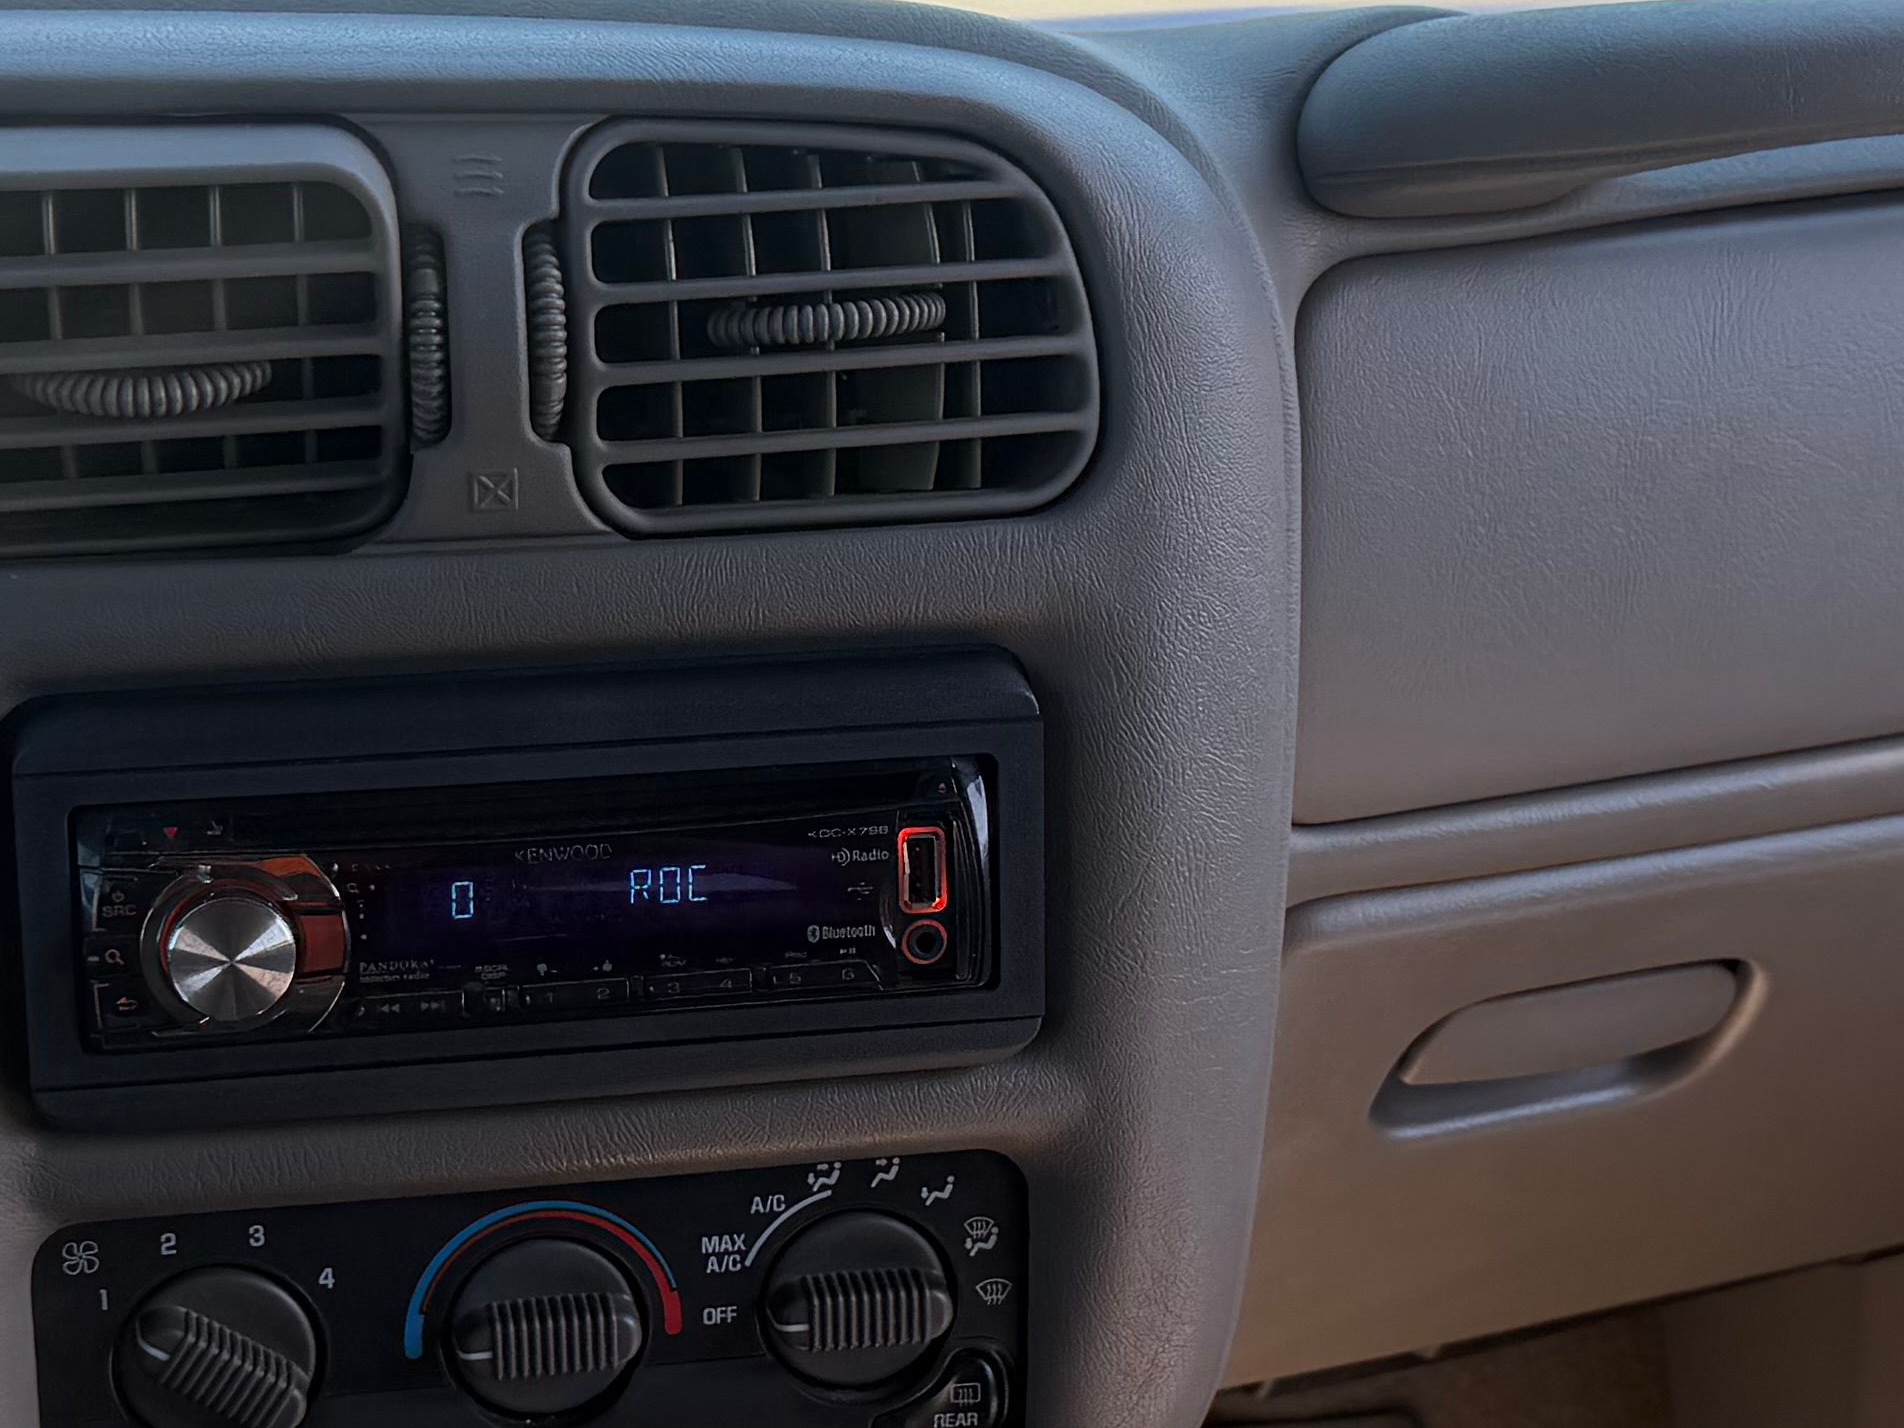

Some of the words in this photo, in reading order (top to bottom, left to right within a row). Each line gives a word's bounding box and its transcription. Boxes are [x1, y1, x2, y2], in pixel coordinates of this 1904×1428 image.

[515, 844, 613, 864] KENWOOD
[852, 848, 889, 862] Radio
[102, 904, 137, 918] SRC
[822, 924, 877, 940] Bluetooth
[750, 1195, 786, 1214] A/C
[160, 1233, 177, 1255] 2
[249, 1225, 266, 1247] 3
[701, 1233, 746, 1254] MAX
[706, 1254, 742, 1273] A/C
[318, 1268, 335, 1289] 4
[99, 1289, 109, 1311] 1
[702, 1306, 737, 1325] OFF
[933, 1412, 978, 1428] REAR
